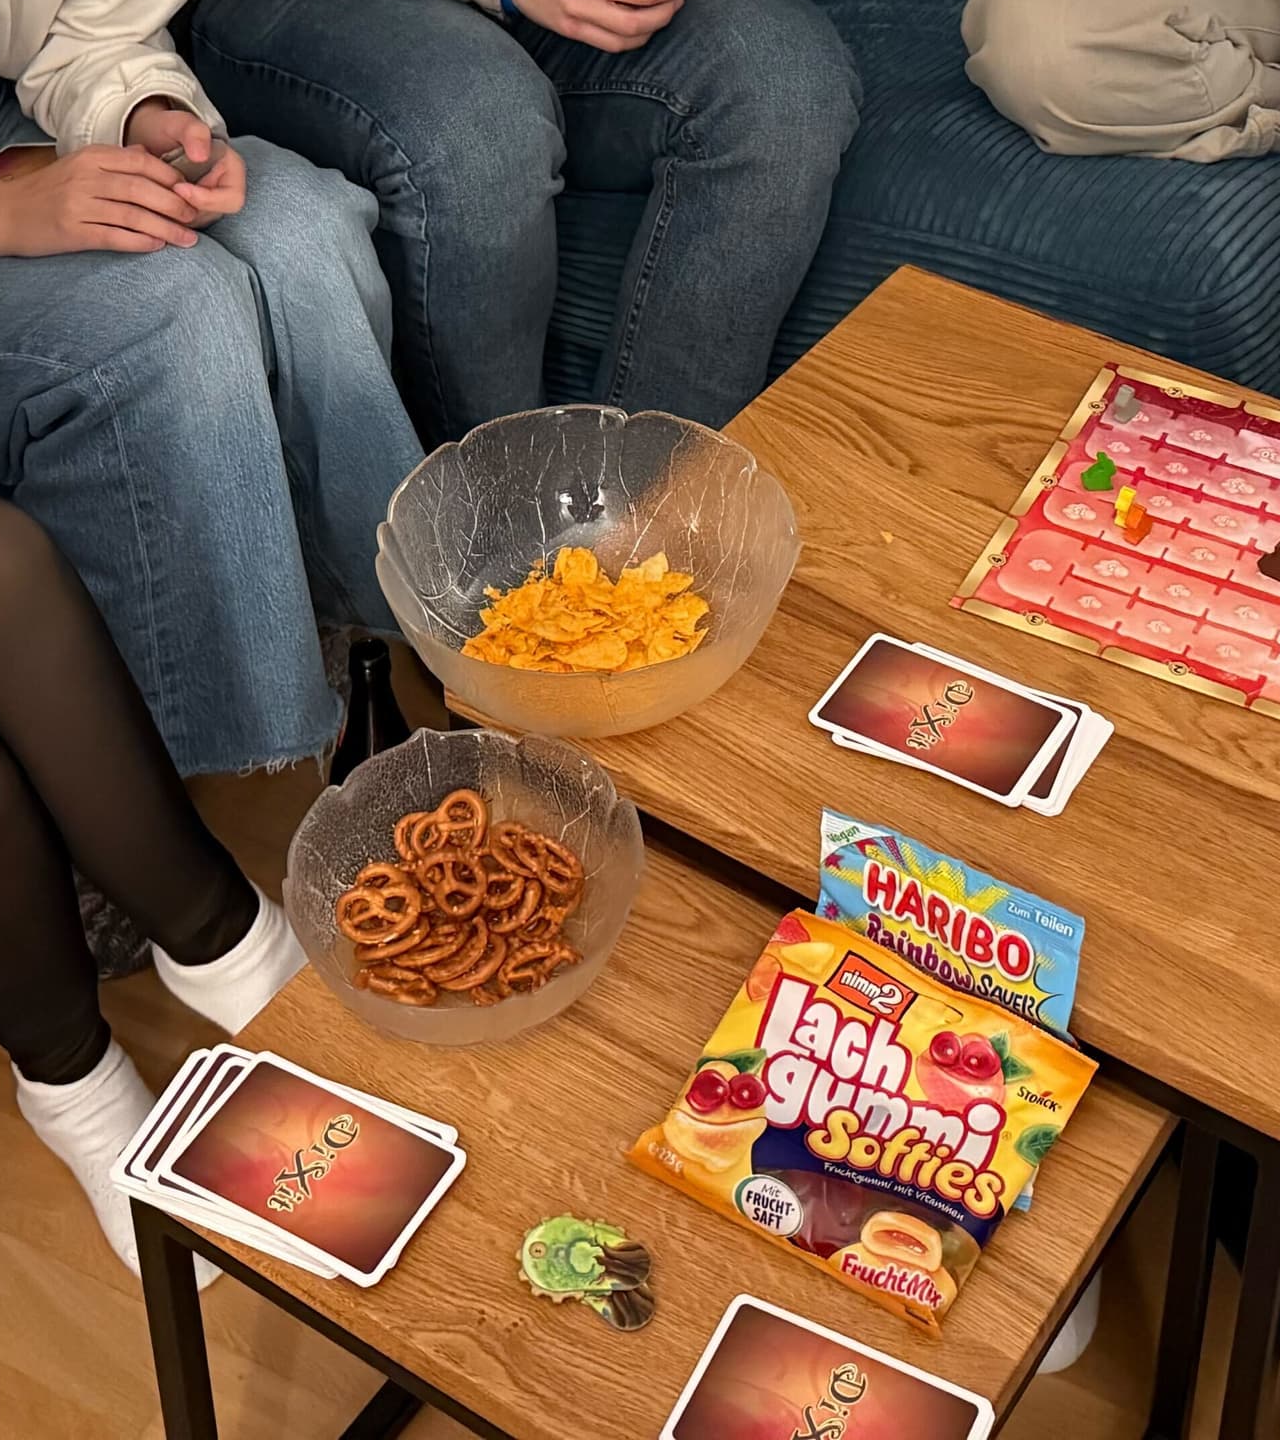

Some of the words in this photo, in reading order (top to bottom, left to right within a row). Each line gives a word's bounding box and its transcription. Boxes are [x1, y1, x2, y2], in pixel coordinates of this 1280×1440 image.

[826, 824, 861, 845] Vegan
[865, 861, 1032, 979] HARIBO
[1006, 901, 1031, 919] Zum
[1034, 910, 1074, 937] Teilen
[866, 912, 973, 990] Rainbow
[839, 970, 905, 1015] nimm2
[976, 974, 1036, 1017] SAUER
[1017, 1085, 1058, 1113] STORCK
[808, 1108, 1004, 1218] Softies
[823, 1162, 892, 1190] Fruchtgummi
[893, 1183, 914, 1198] mit
[745, 1190, 795, 1217] FRUCHT-
[761, 1183, 782, 1198] Mit
[752, 1208, 783, 1230] SAFT
[839, 1252, 943, 1309] FruchtMix
